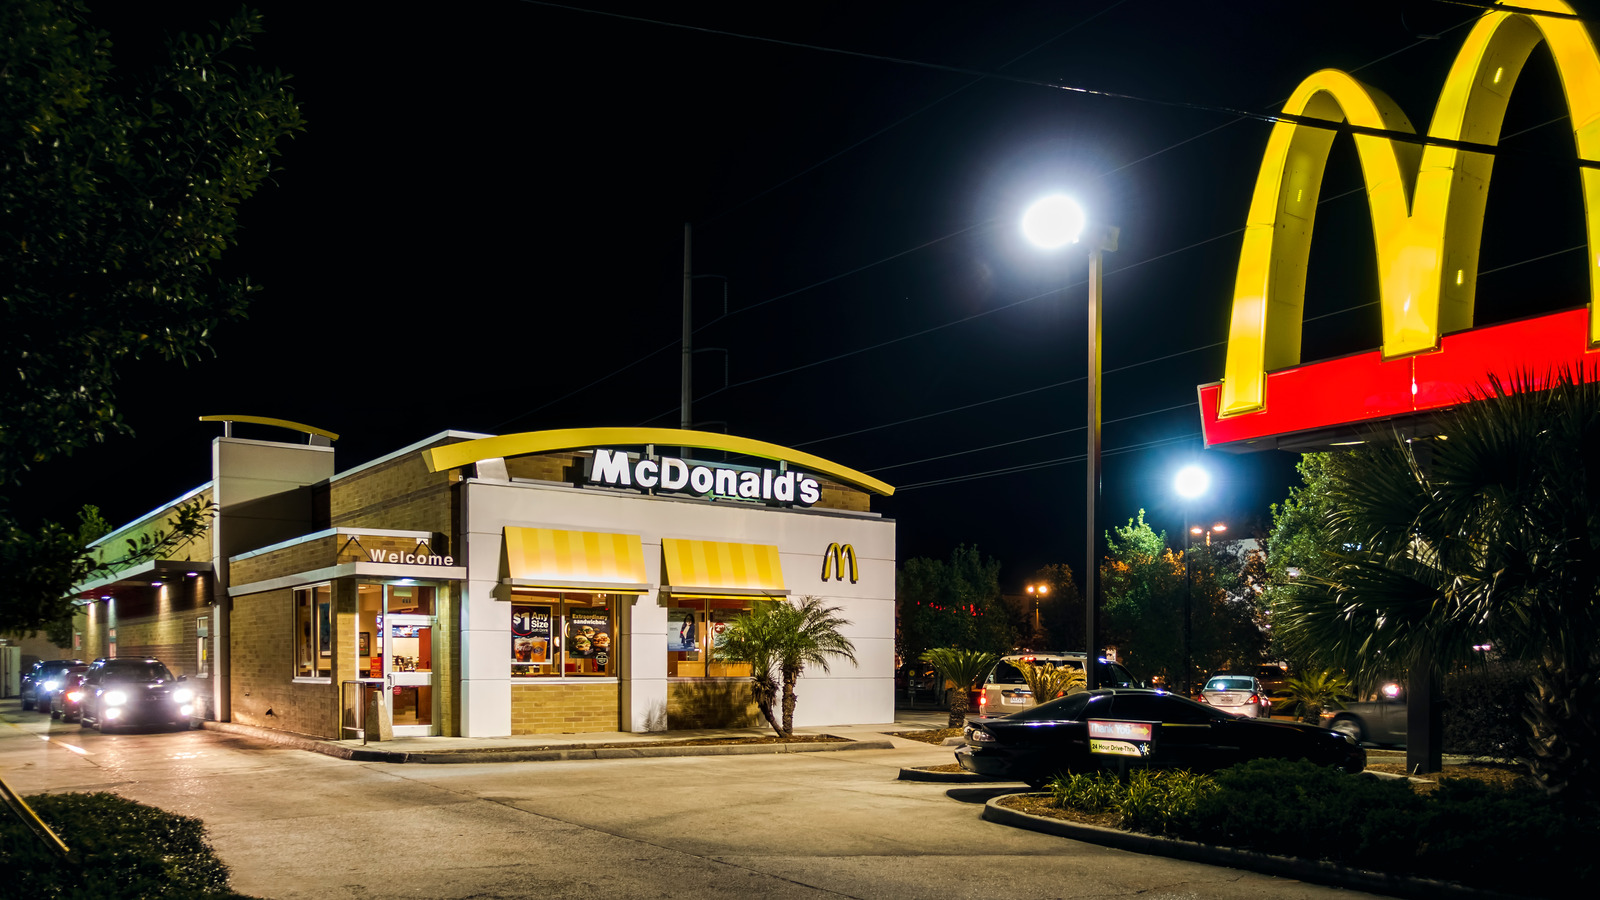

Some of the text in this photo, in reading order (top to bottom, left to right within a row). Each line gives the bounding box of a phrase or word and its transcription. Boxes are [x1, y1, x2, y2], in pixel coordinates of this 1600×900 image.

[590, 449, 820, 504] McDonald's
[370, 549, 454, 566] Welcome
[513, 612, 530, 630] $1
[531, 612, 548, 621] Any
[572, 613, 608, 621] Extraordinary
[531, 620, 549, 628] Size
[1090, 722, 1131, 735] Thank You
[1111, 744, 1136, 752] Drive-Thru
